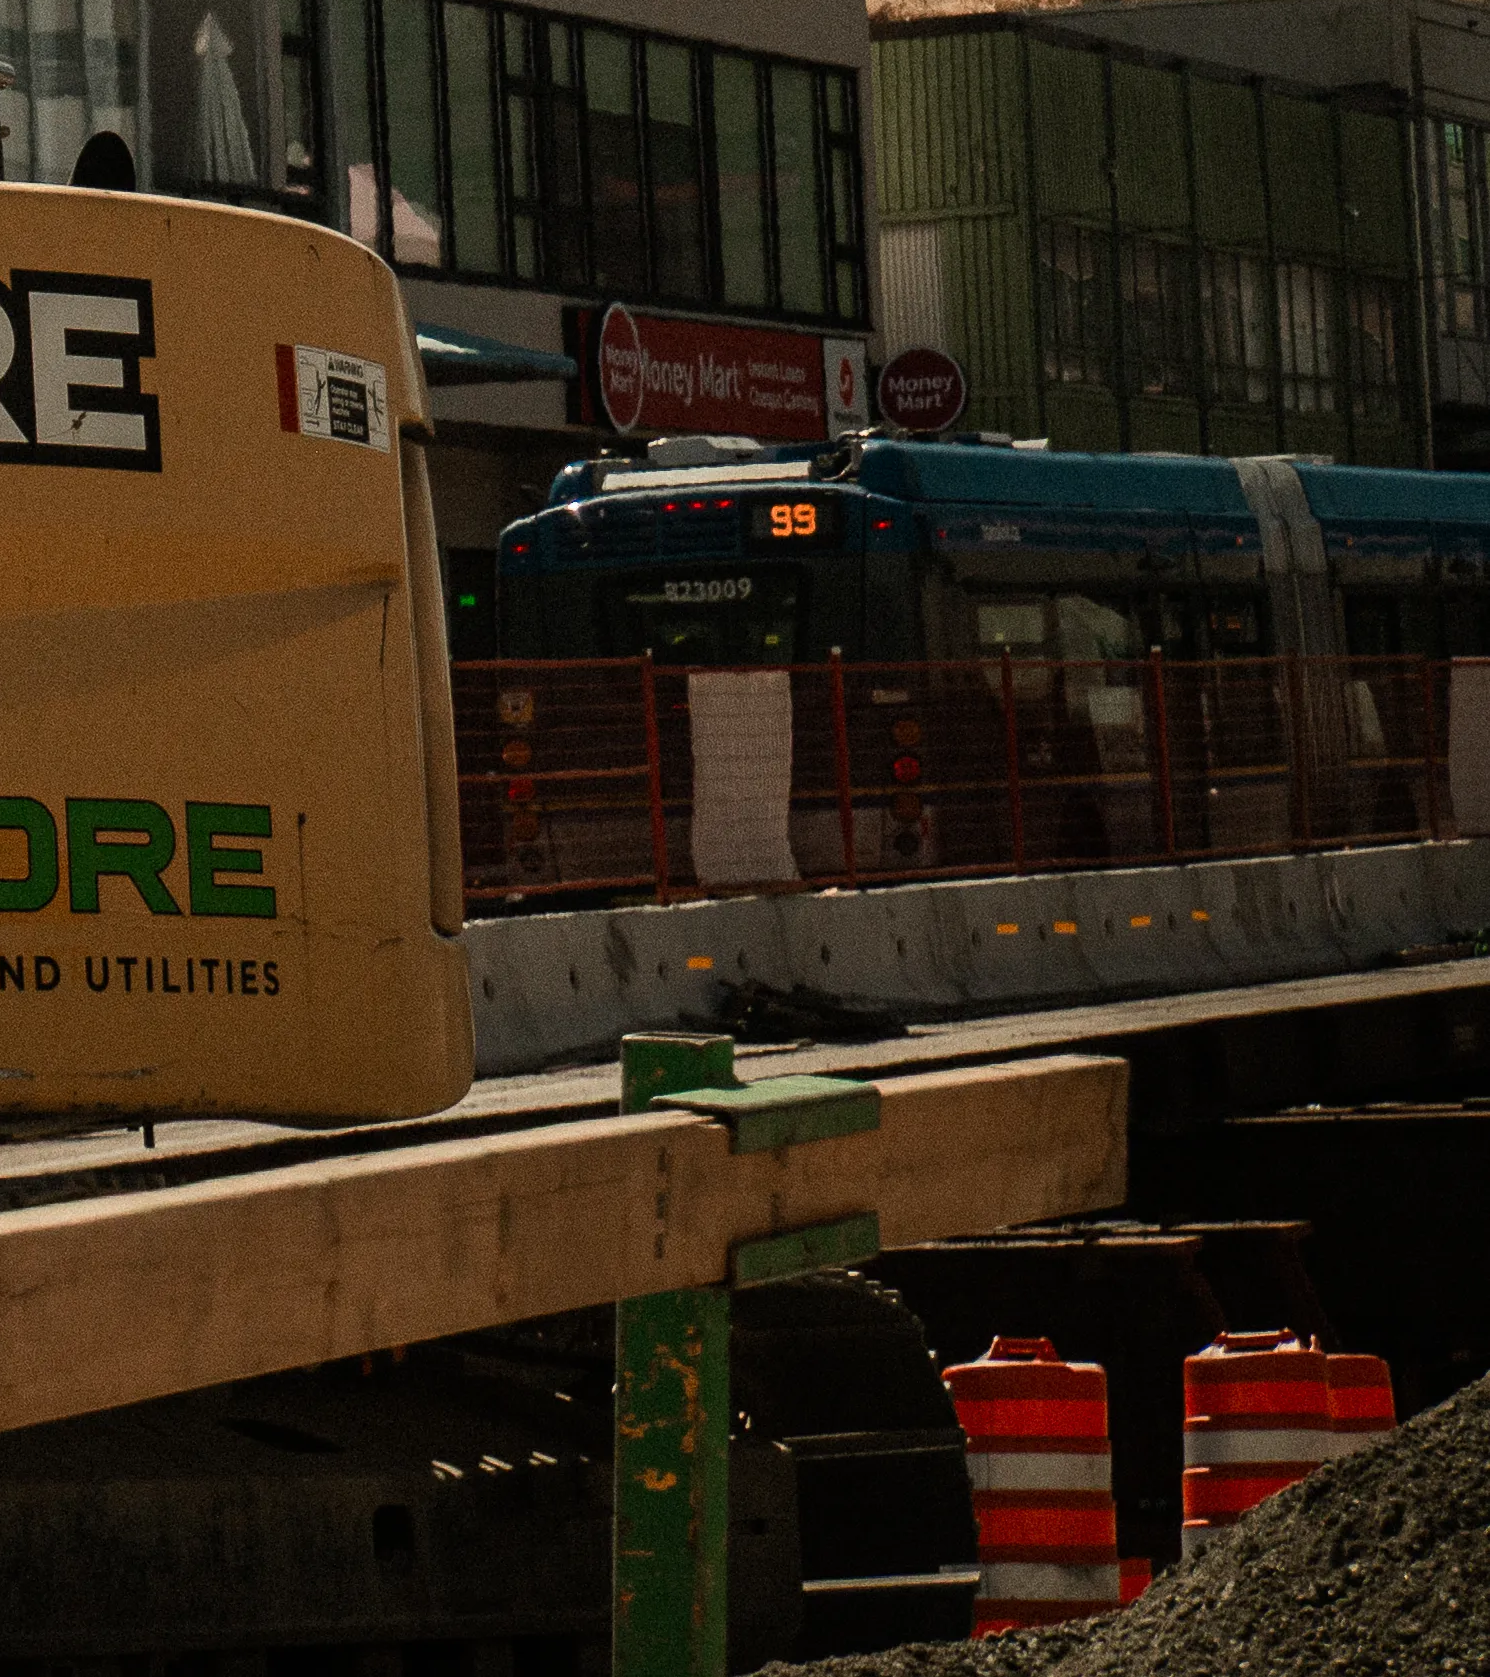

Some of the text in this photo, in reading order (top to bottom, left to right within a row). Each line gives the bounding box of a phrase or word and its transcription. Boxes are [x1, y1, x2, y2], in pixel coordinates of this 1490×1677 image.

[698, 352, 741, 401] Mart
[887, 374, 955, 394] Money
[896, 392, 944, 413] Mart
[770, 502, 818, 539] 99
[84, 956, 281, 997] UTILITIES
